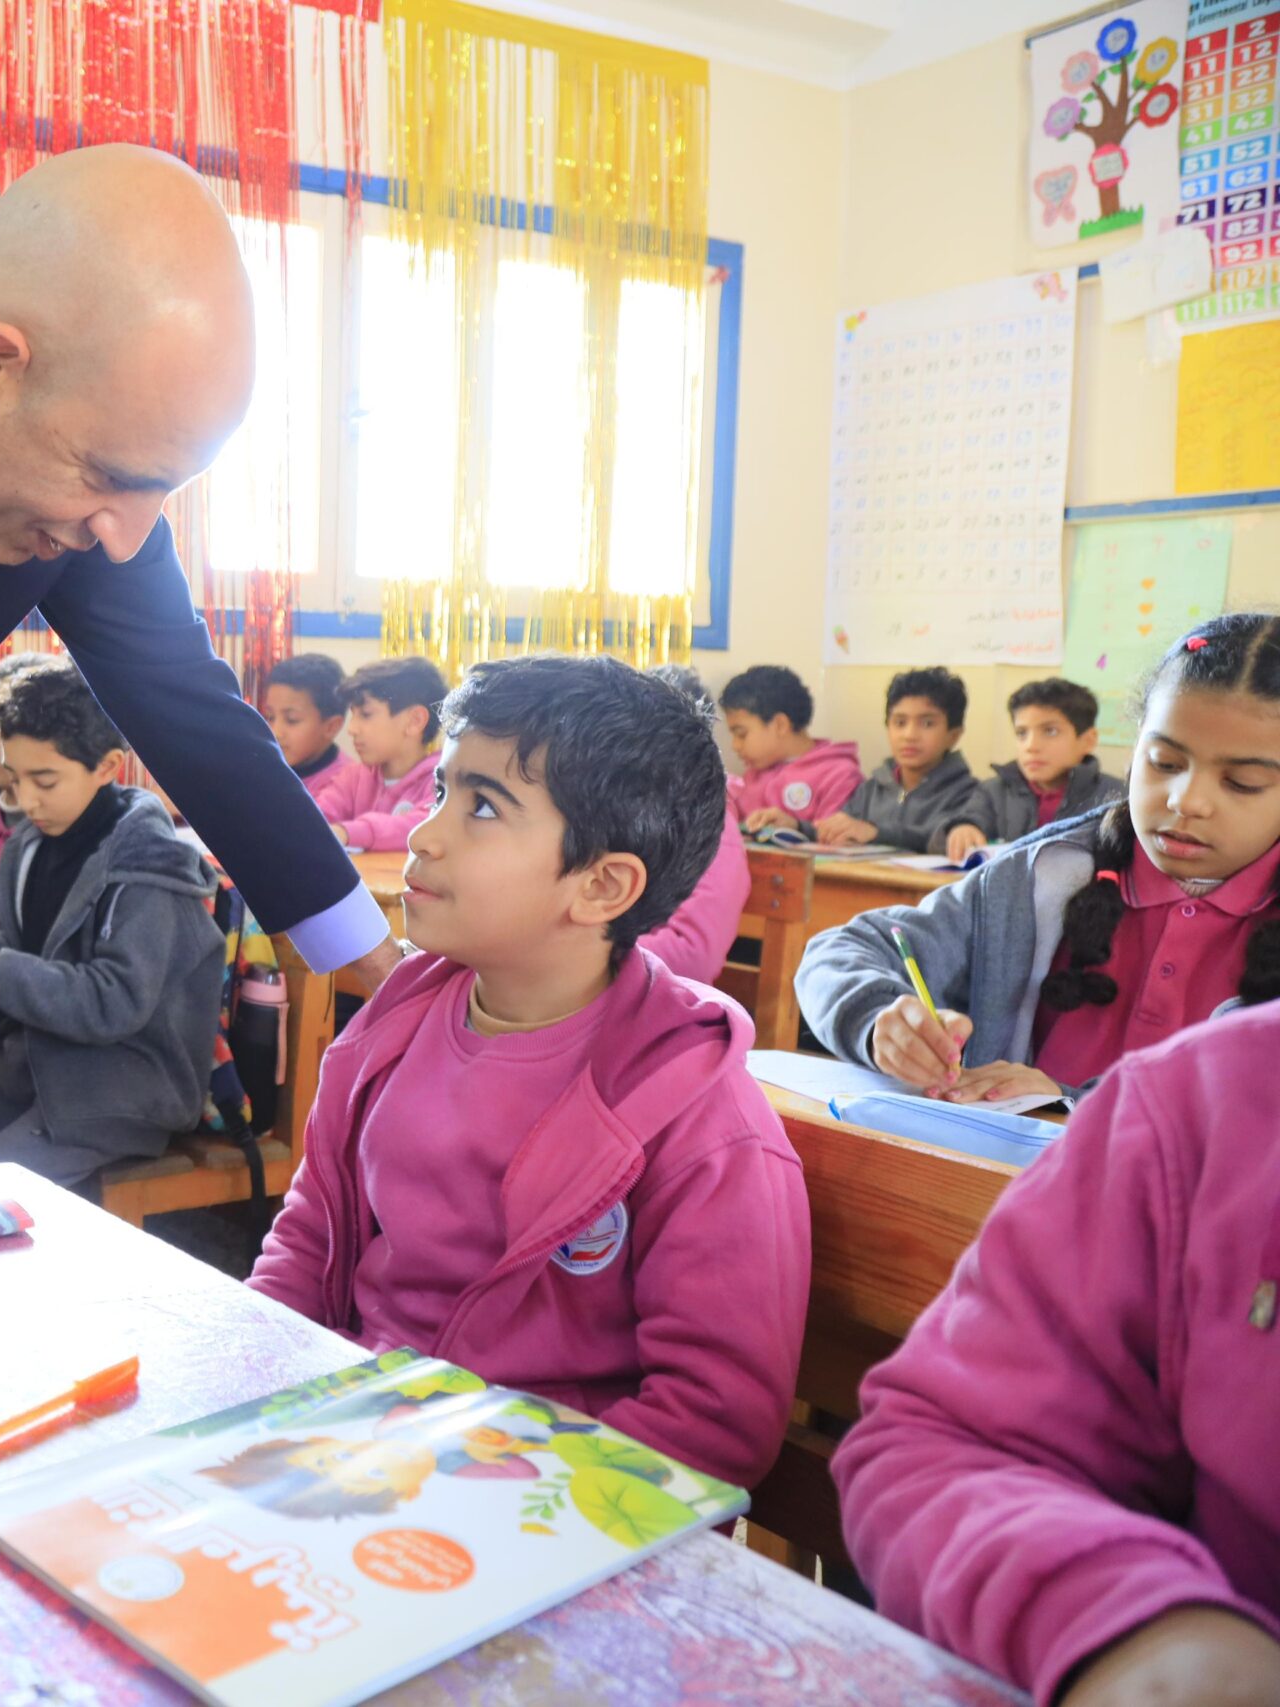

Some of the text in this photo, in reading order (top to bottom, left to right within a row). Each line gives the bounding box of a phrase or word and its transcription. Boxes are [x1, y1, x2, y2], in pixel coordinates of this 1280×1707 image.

[1249, 19, 1266, 38] 2
[1199, 36, 1210, 53] 1
[1240, 40, 1272, 62] 12
[1191, 56, 1216, 78] 11
[1238, 63, 1270, 87] 22
[1187, 80, 1214, 100] 21
[1236, 89, 1266, 109] 32
[1187, 102, 1212, 123] 31
[1234, 111, 1266, 130] 42
[1184, 126, 1211, 144] 41
[1231, 140, 1264, 161] 52
[1183, 153, 1211, 174] 51
[1229, 166, 1263, 186] 62
[1182, 178, 1209, 198] 61
[1227, 191, 1261, 213] 72
[1180, 203, 1208, 224] 71
[1226, 218, 1259, 239] 82
[1224, 243, 1257, 264] 92
[1227, 268, 1262, 290] 102
[1183, 301, 1210, 320] 111
[1226, 292, 1257, 313] 112
[153, 1525, 359, 1653] العربية
